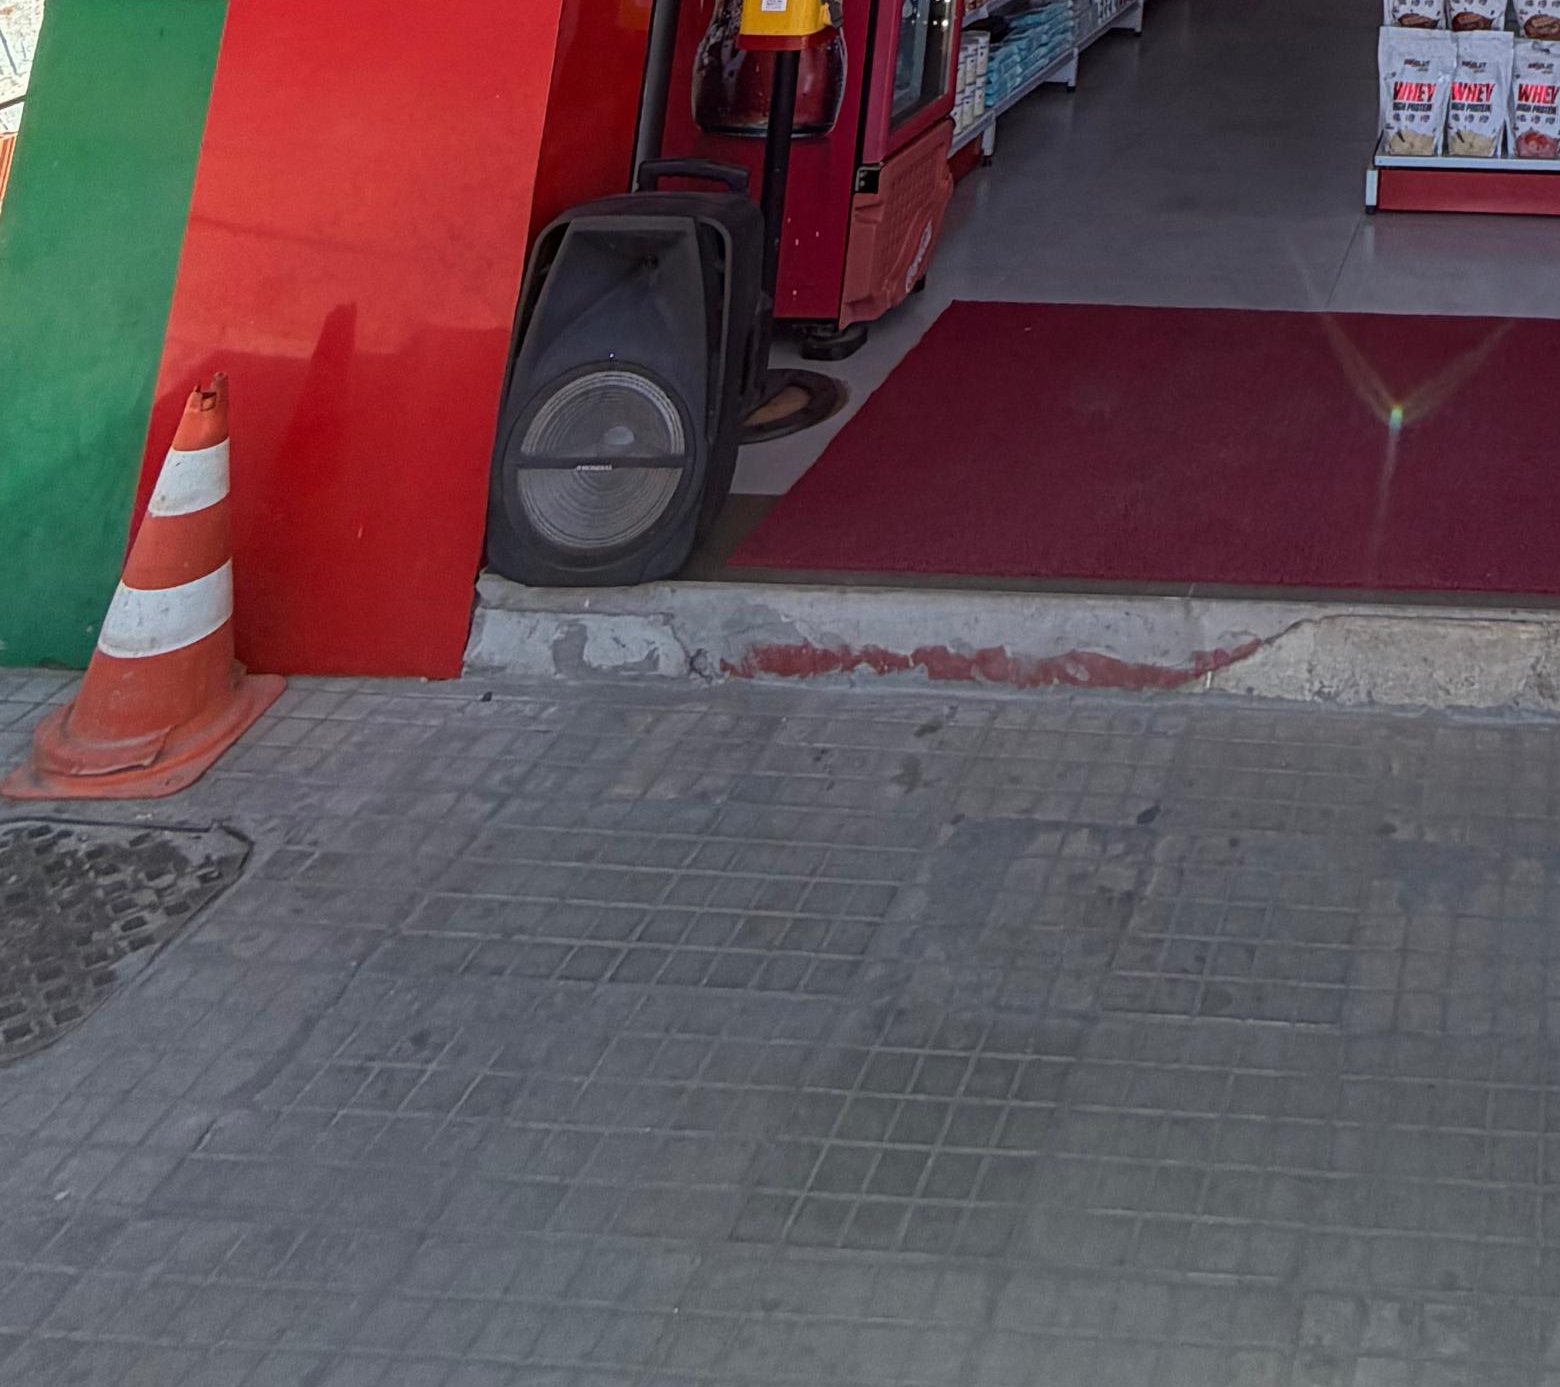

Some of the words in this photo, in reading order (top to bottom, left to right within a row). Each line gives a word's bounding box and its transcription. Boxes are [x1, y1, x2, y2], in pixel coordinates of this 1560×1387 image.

[1393, 81, 1436, 102] WHEY
[1451, 81, 1496, 103] WHEY
[1517, 83, 1560, 104] WHEY
